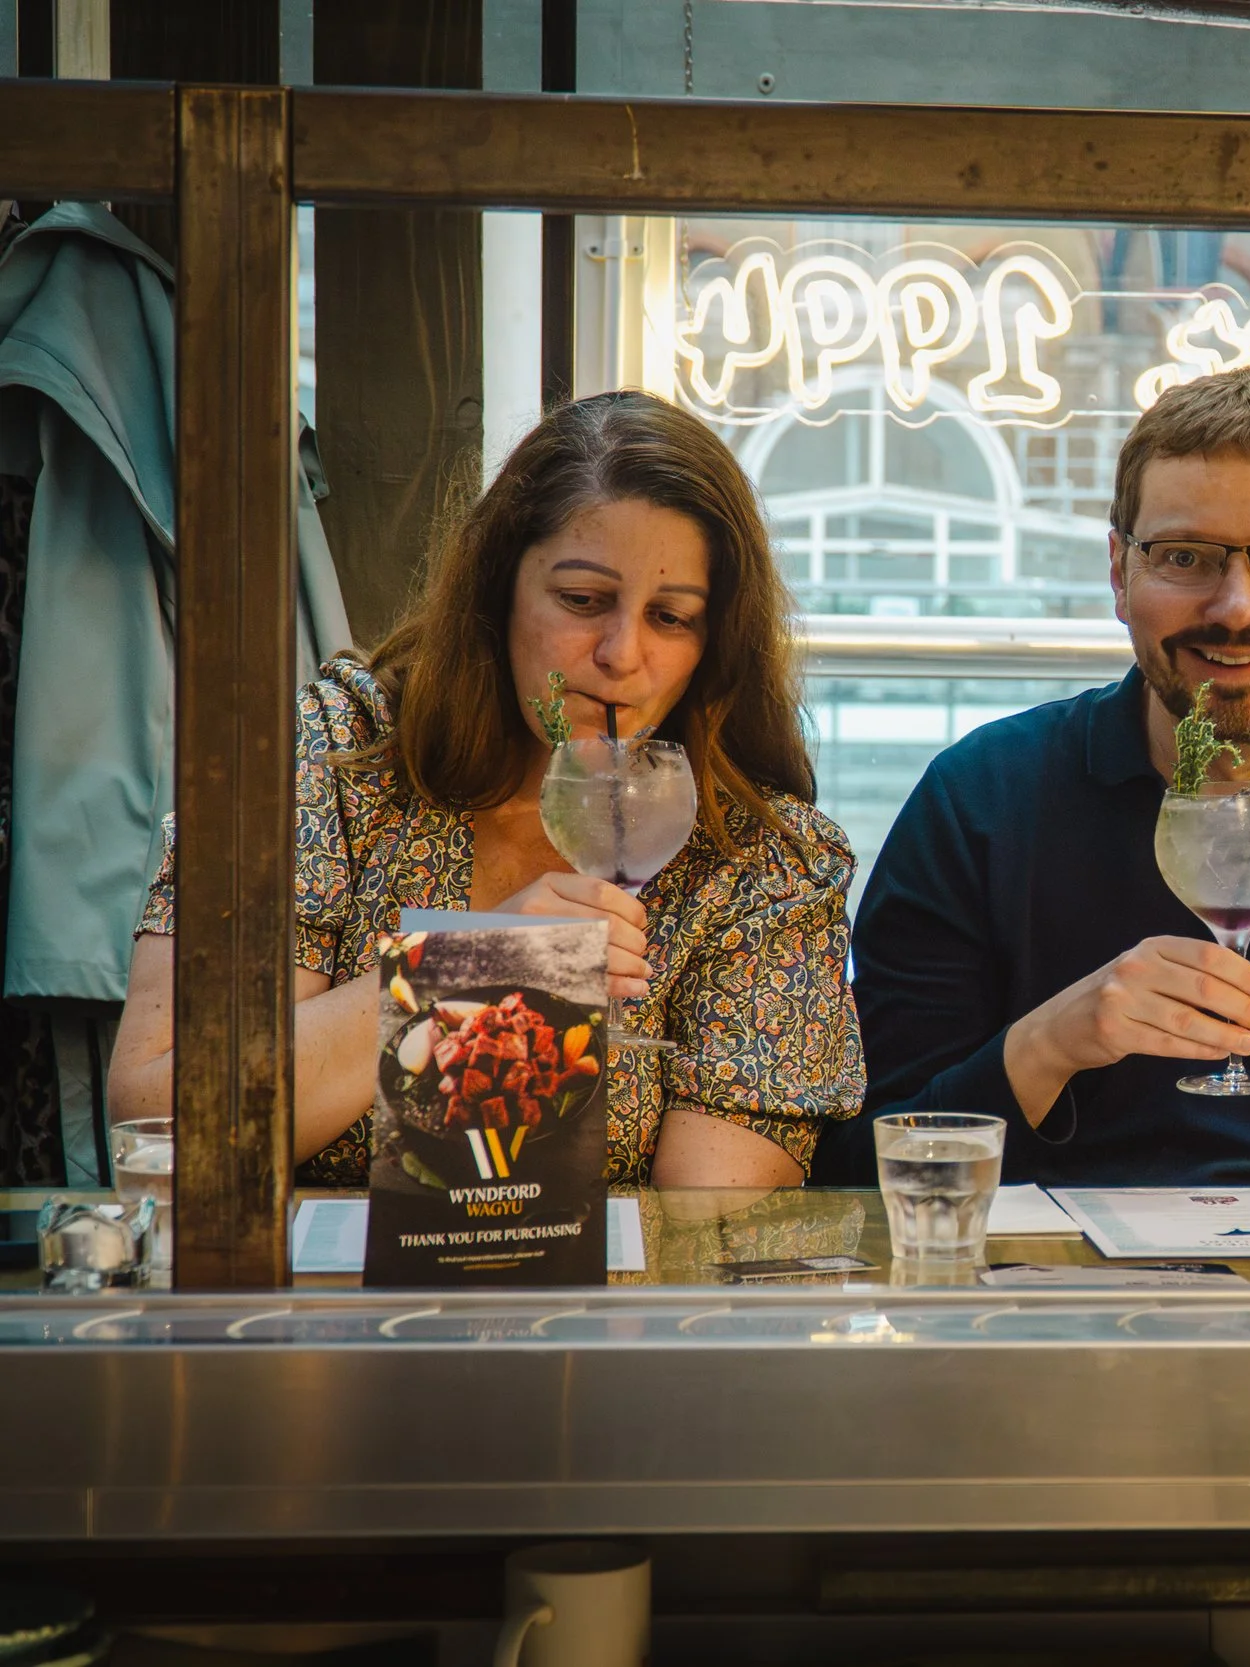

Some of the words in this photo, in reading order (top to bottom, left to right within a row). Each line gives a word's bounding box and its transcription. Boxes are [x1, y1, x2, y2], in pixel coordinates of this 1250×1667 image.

[448, 1183, 542, 1204] WYNDFORD
[466, 1200, 524, 1217] WAGYU
[398, 1233, 446, 1248] THANK
[447, 1231, 475, 1244] YOU
[476, 1229, 502, 1243] FOR
[504, 1223, 582, 1241] PURCHASING
